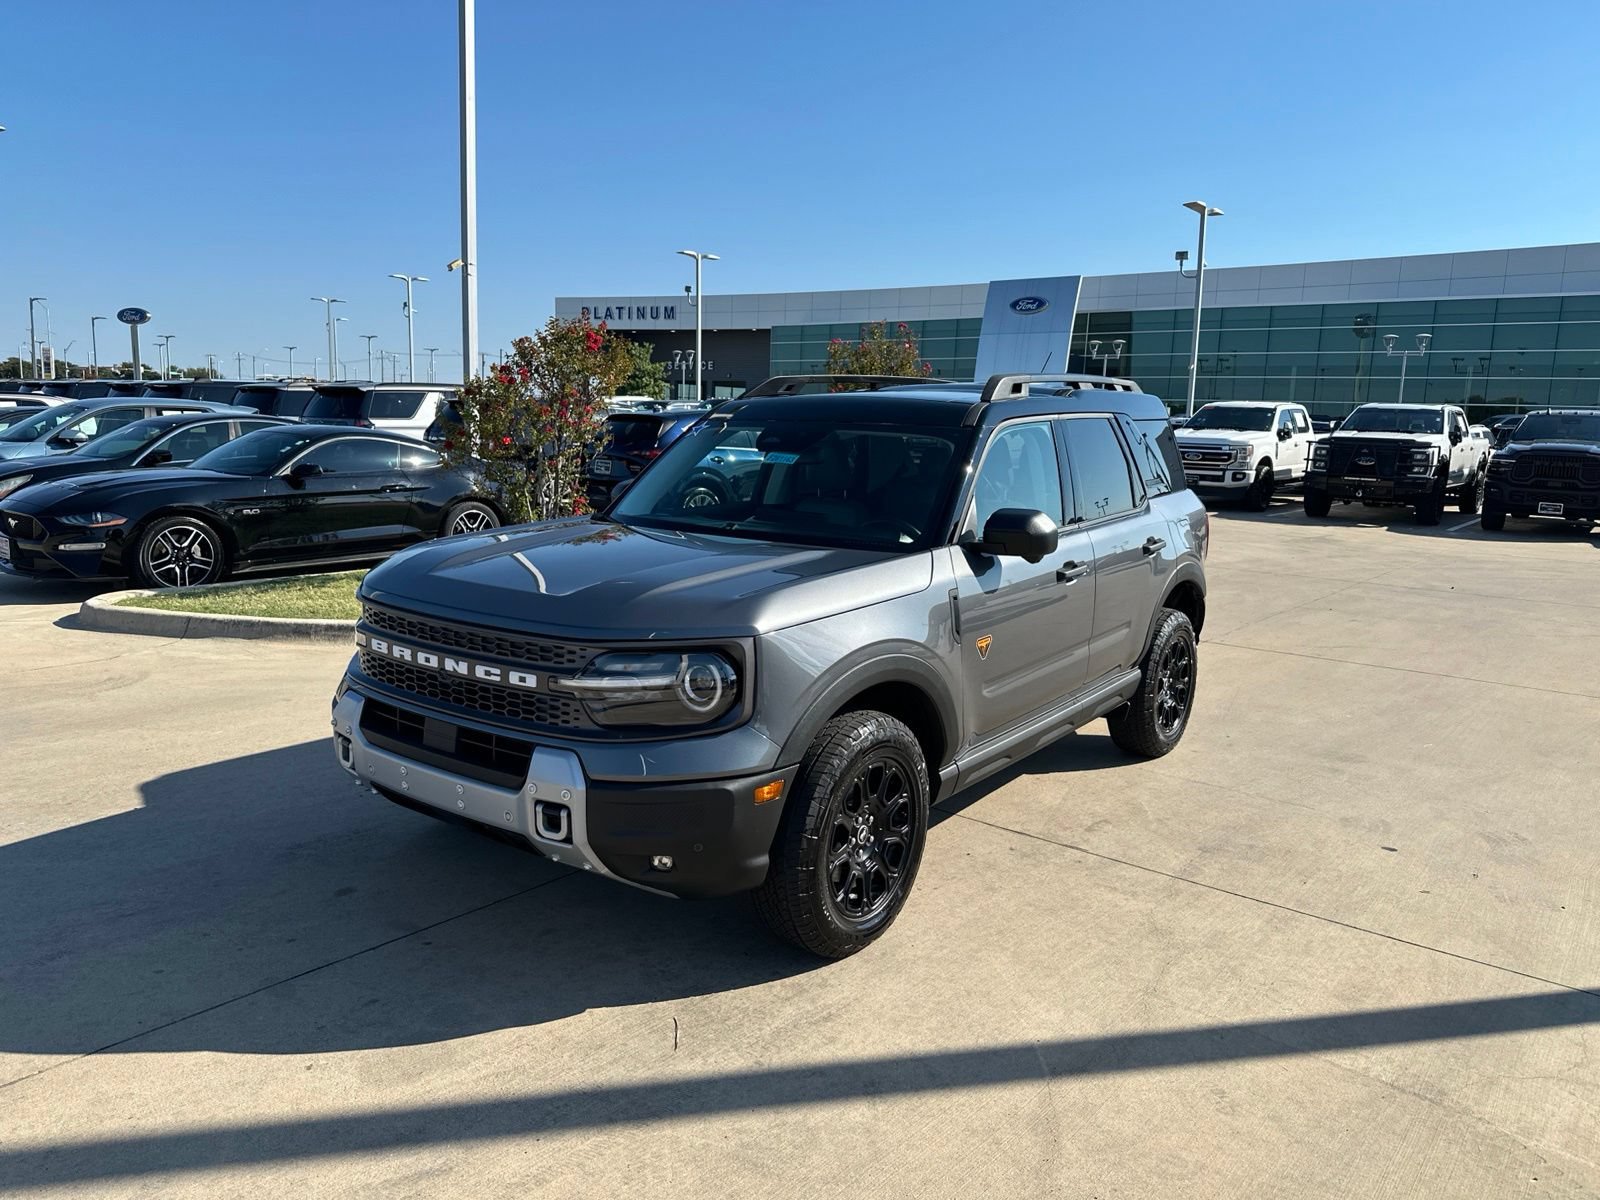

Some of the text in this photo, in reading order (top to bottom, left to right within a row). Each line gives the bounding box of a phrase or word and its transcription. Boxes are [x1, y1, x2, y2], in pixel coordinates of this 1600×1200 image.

[1016, 299, 1039, 311] Ford
[122, 310, 141, 321] Ford
[581, 306, 676, 320] PLATINUM
[667, 360, 714, 370] SEVCE
[371, 638, 537, 688] BRONCO
